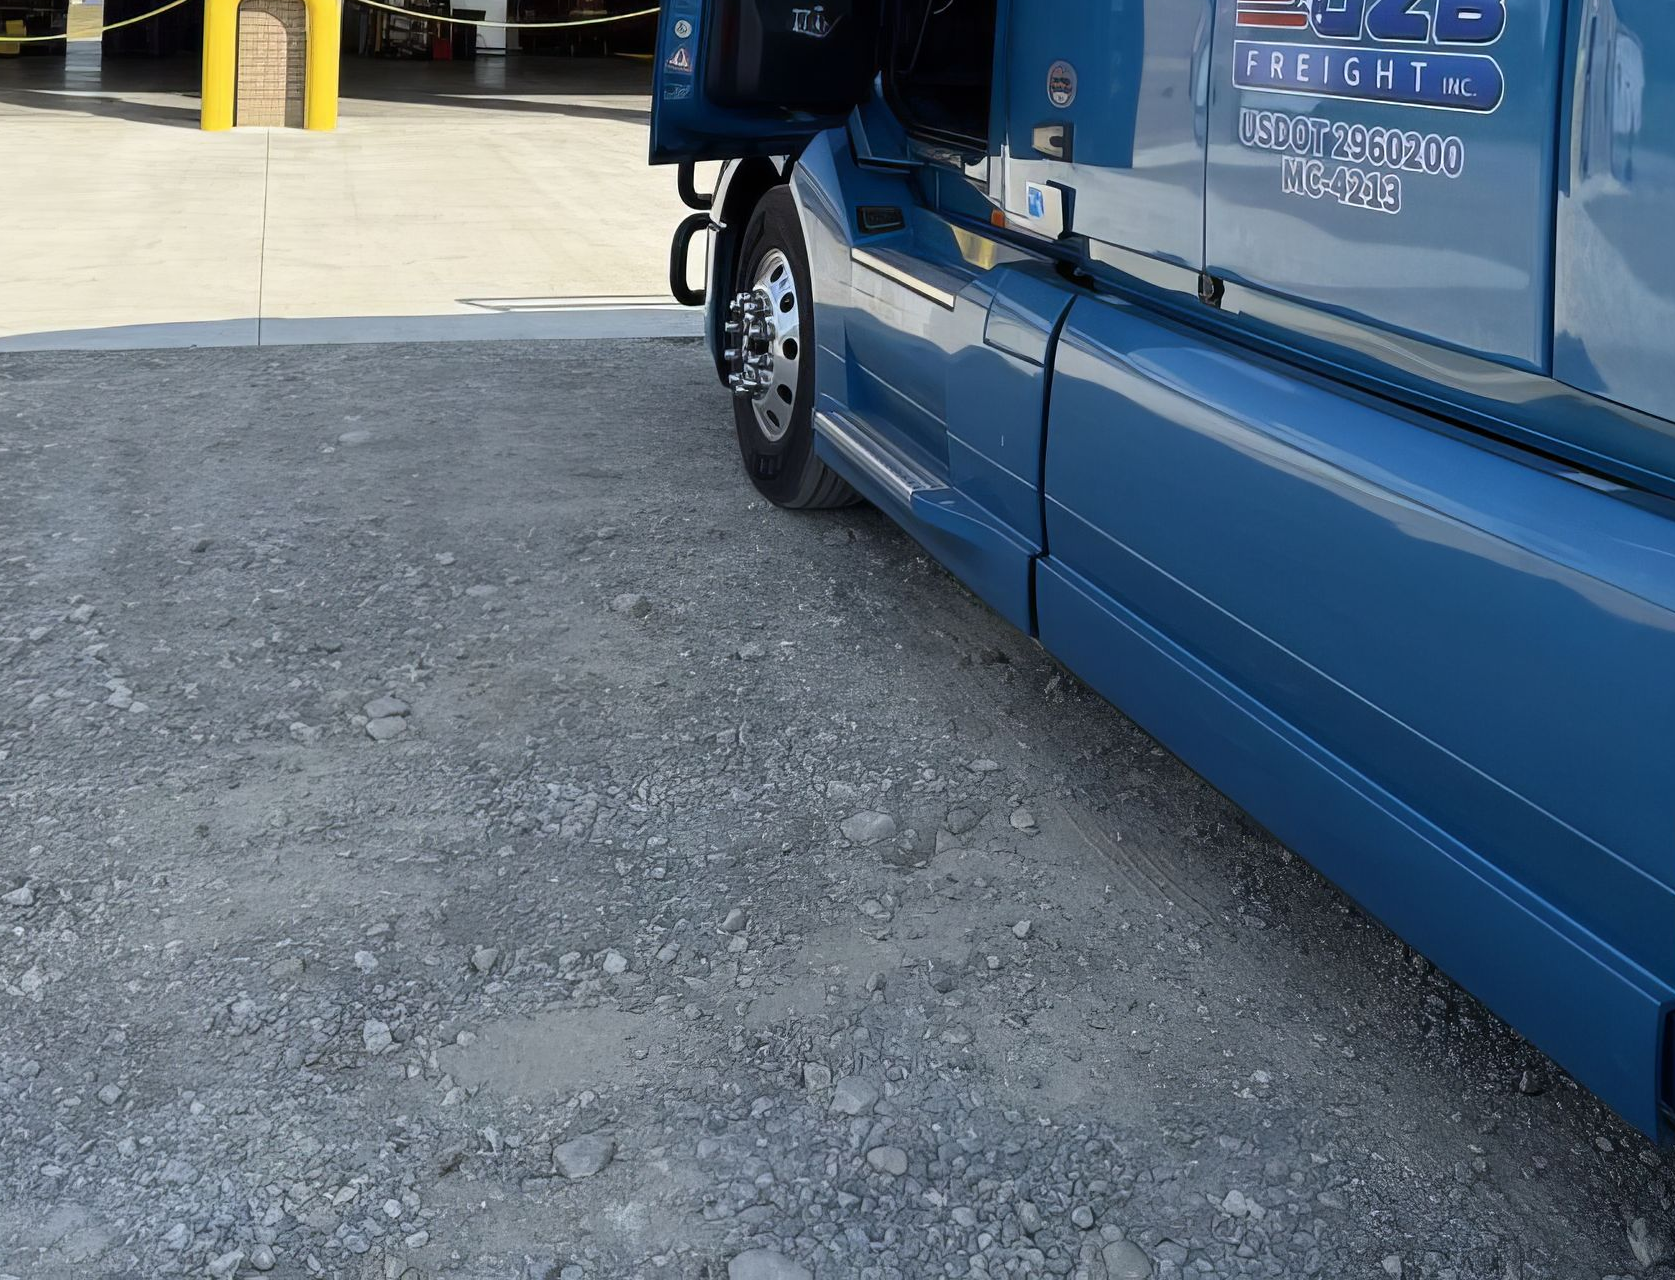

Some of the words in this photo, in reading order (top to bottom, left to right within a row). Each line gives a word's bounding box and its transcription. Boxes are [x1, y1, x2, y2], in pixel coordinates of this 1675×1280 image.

[1246, 50, 1428, 93] FREIGHT
[1442, 77, 1477, 97] INC.
[1238, 108, 1331, 157] USDOT
[1331, 121, 1465, 179] 2960200
[1281, 155, 1402, 215] MC-4213
